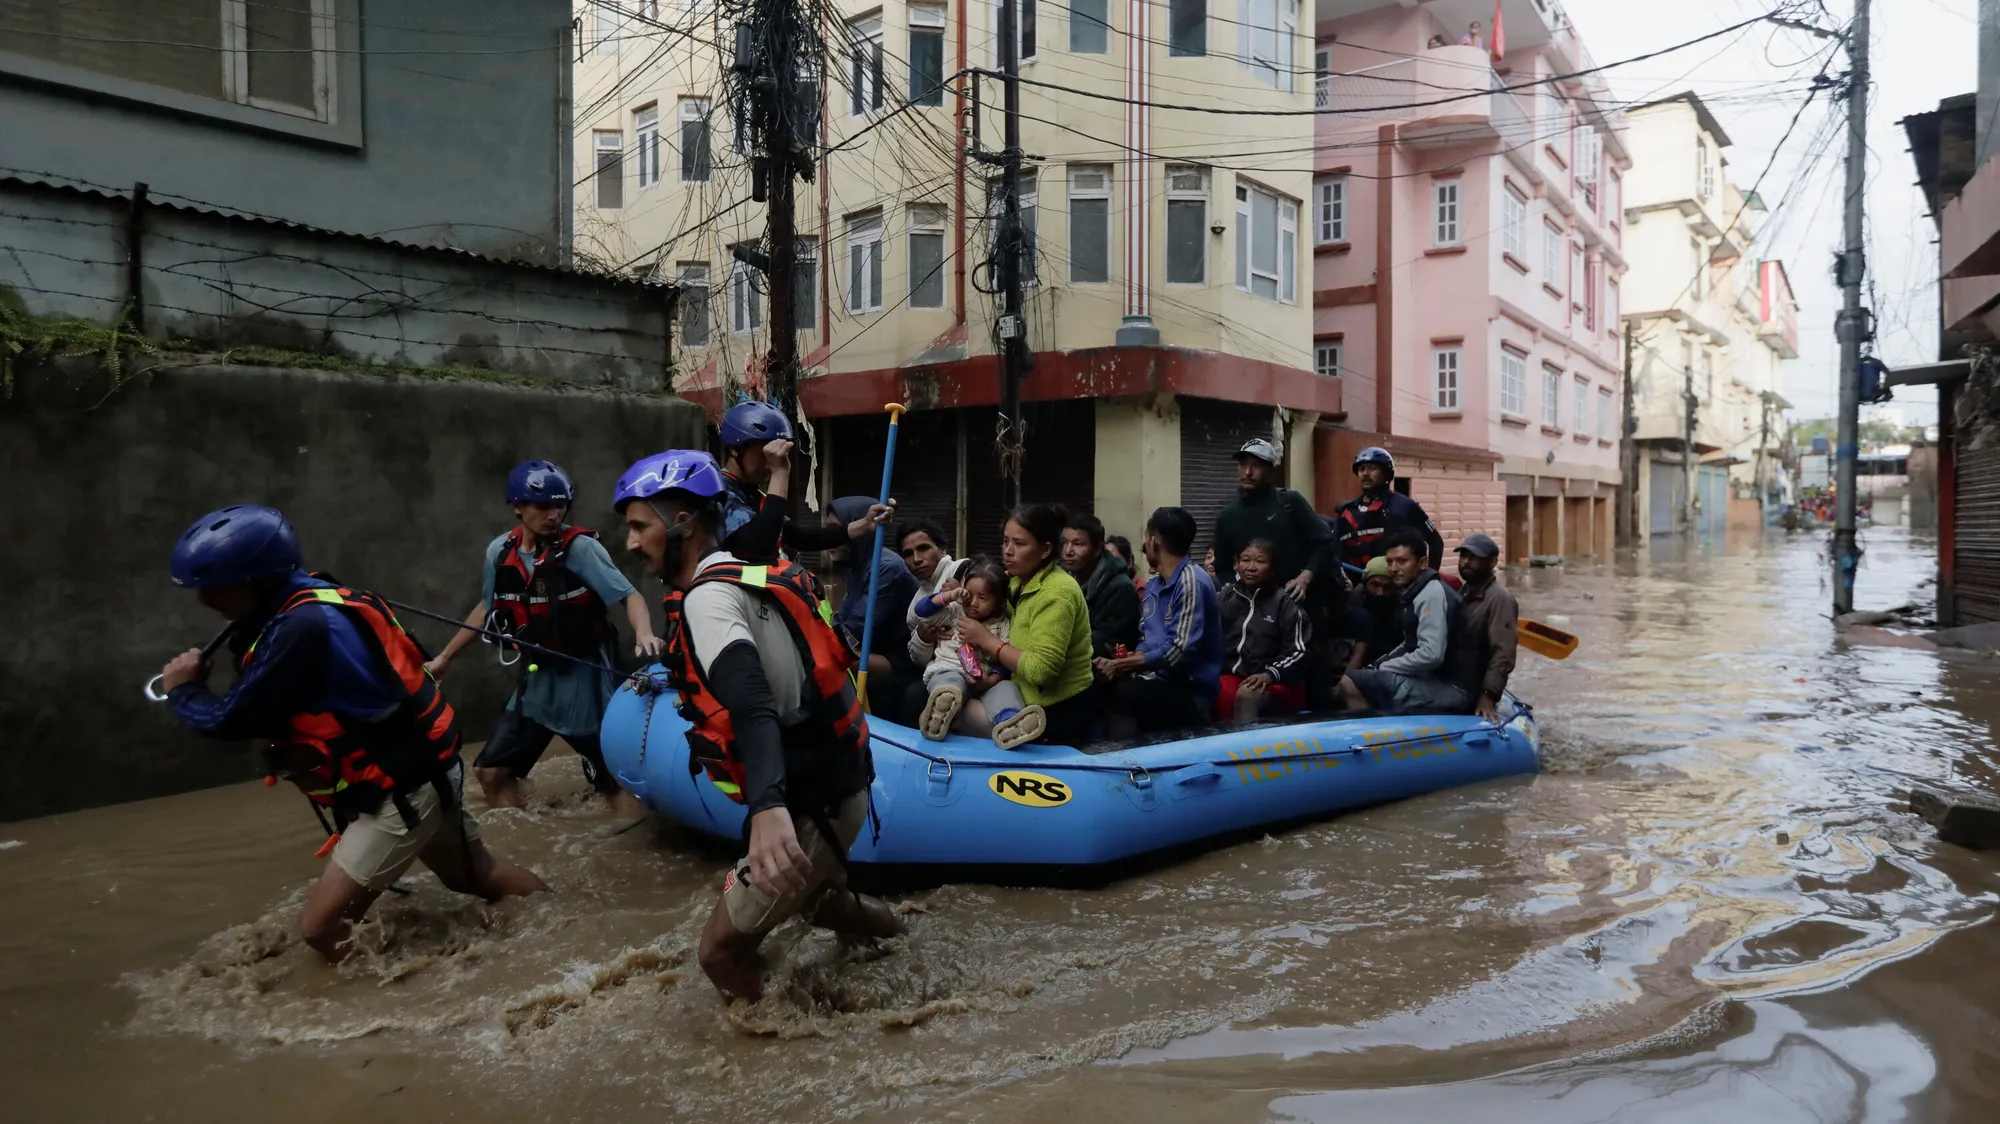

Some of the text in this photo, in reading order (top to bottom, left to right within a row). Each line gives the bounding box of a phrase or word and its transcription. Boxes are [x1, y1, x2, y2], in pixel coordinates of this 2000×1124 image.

[1227, 727, 1459, 785] NEPAL POLICE
[997, 774, 1067, 802] NRS
